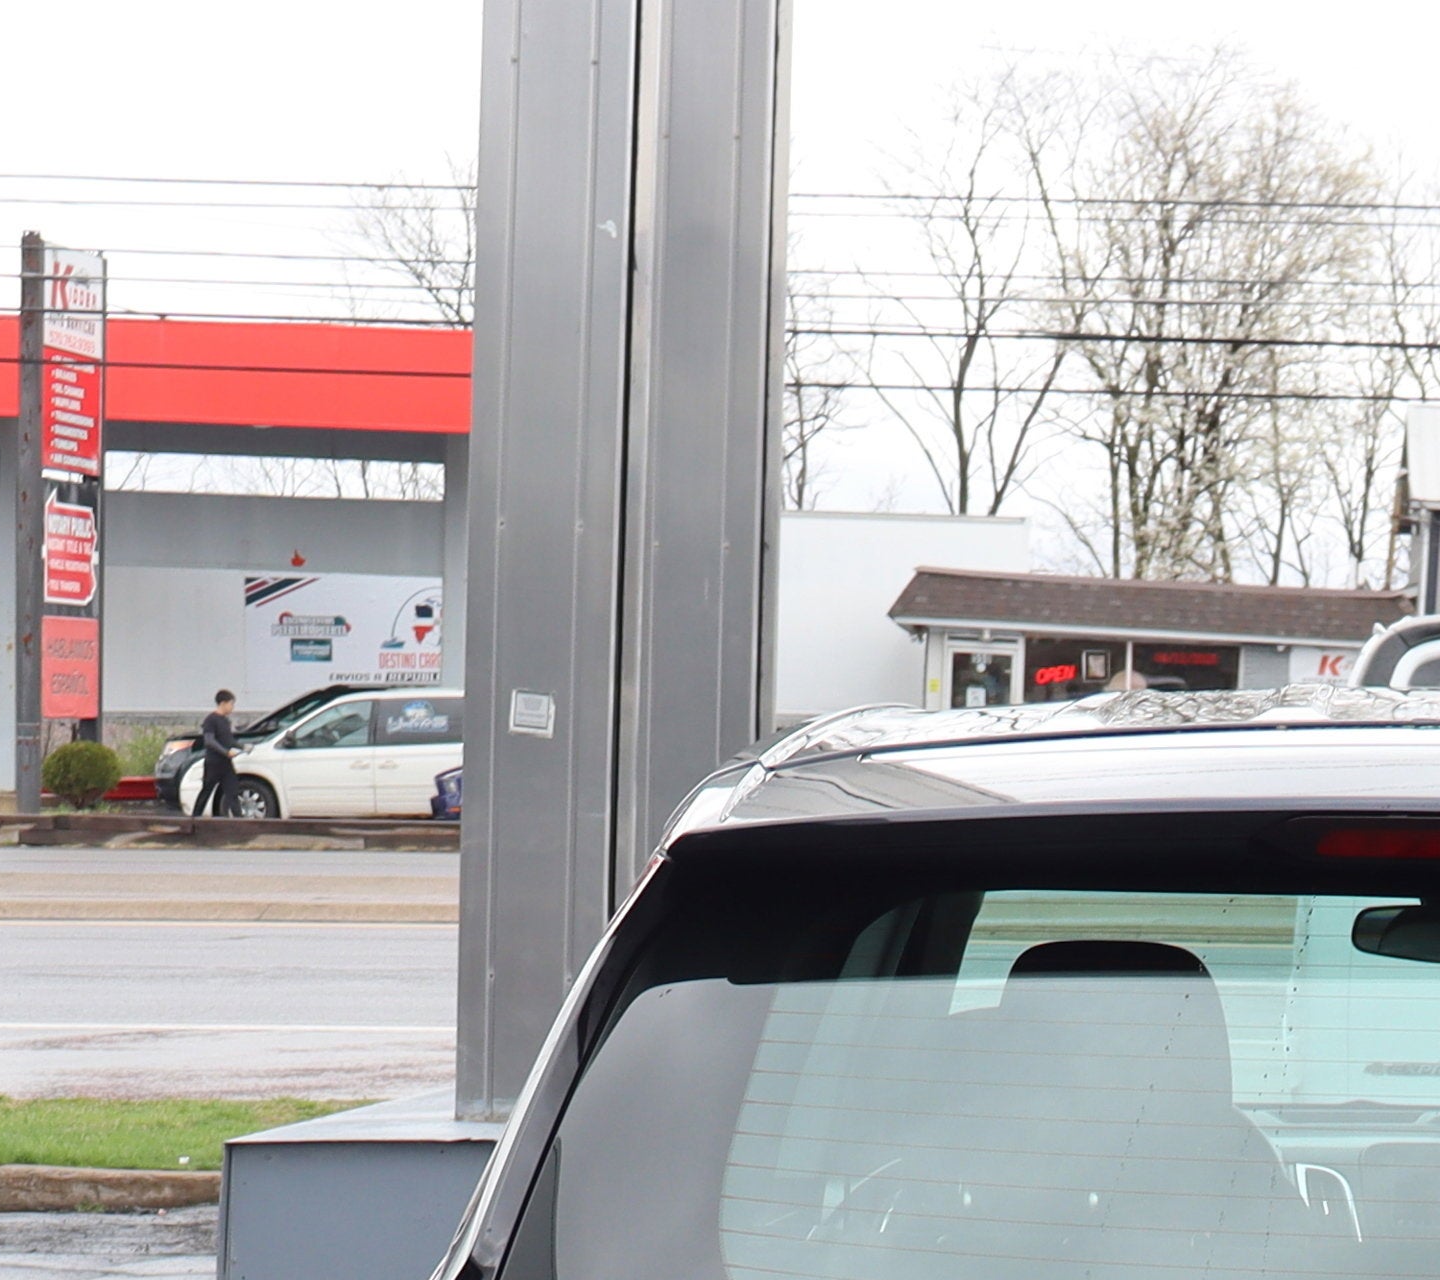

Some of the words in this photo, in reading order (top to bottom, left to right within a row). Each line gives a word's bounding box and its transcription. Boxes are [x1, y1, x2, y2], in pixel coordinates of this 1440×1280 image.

[47, 513, 71, 536] NOTARY
[72, 517, 92, 539] PUBLIC
[379, 652, 416, 669] DESTINO
[1035, 665, 1077, 685] OPEN
